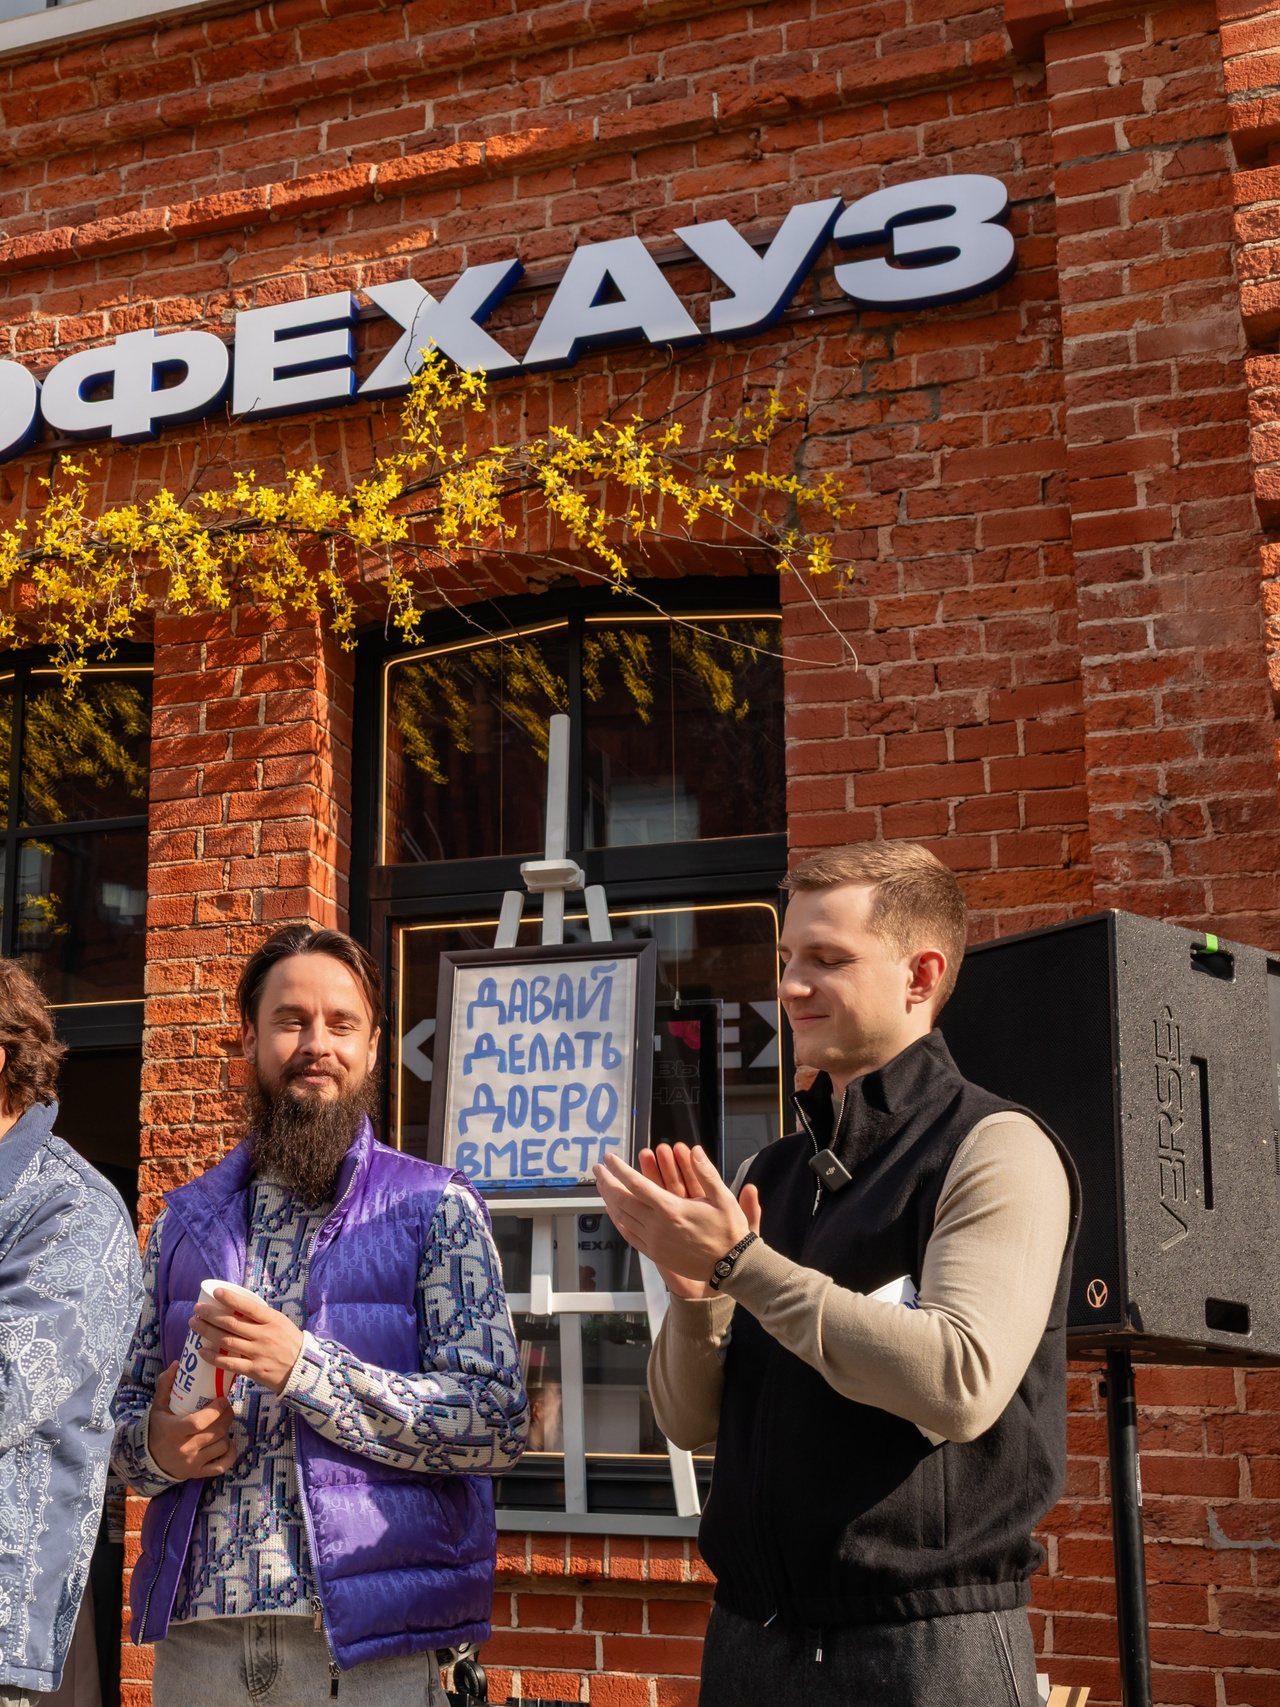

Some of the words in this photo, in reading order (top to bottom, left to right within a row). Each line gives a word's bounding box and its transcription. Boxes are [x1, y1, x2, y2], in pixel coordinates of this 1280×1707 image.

[467, 961, 618, 1030] ДАВАЙ
[463, 1032, 622, 1076] ДЕЛАТЬ
[458, 1082, 619, 1136] ДОБРО
